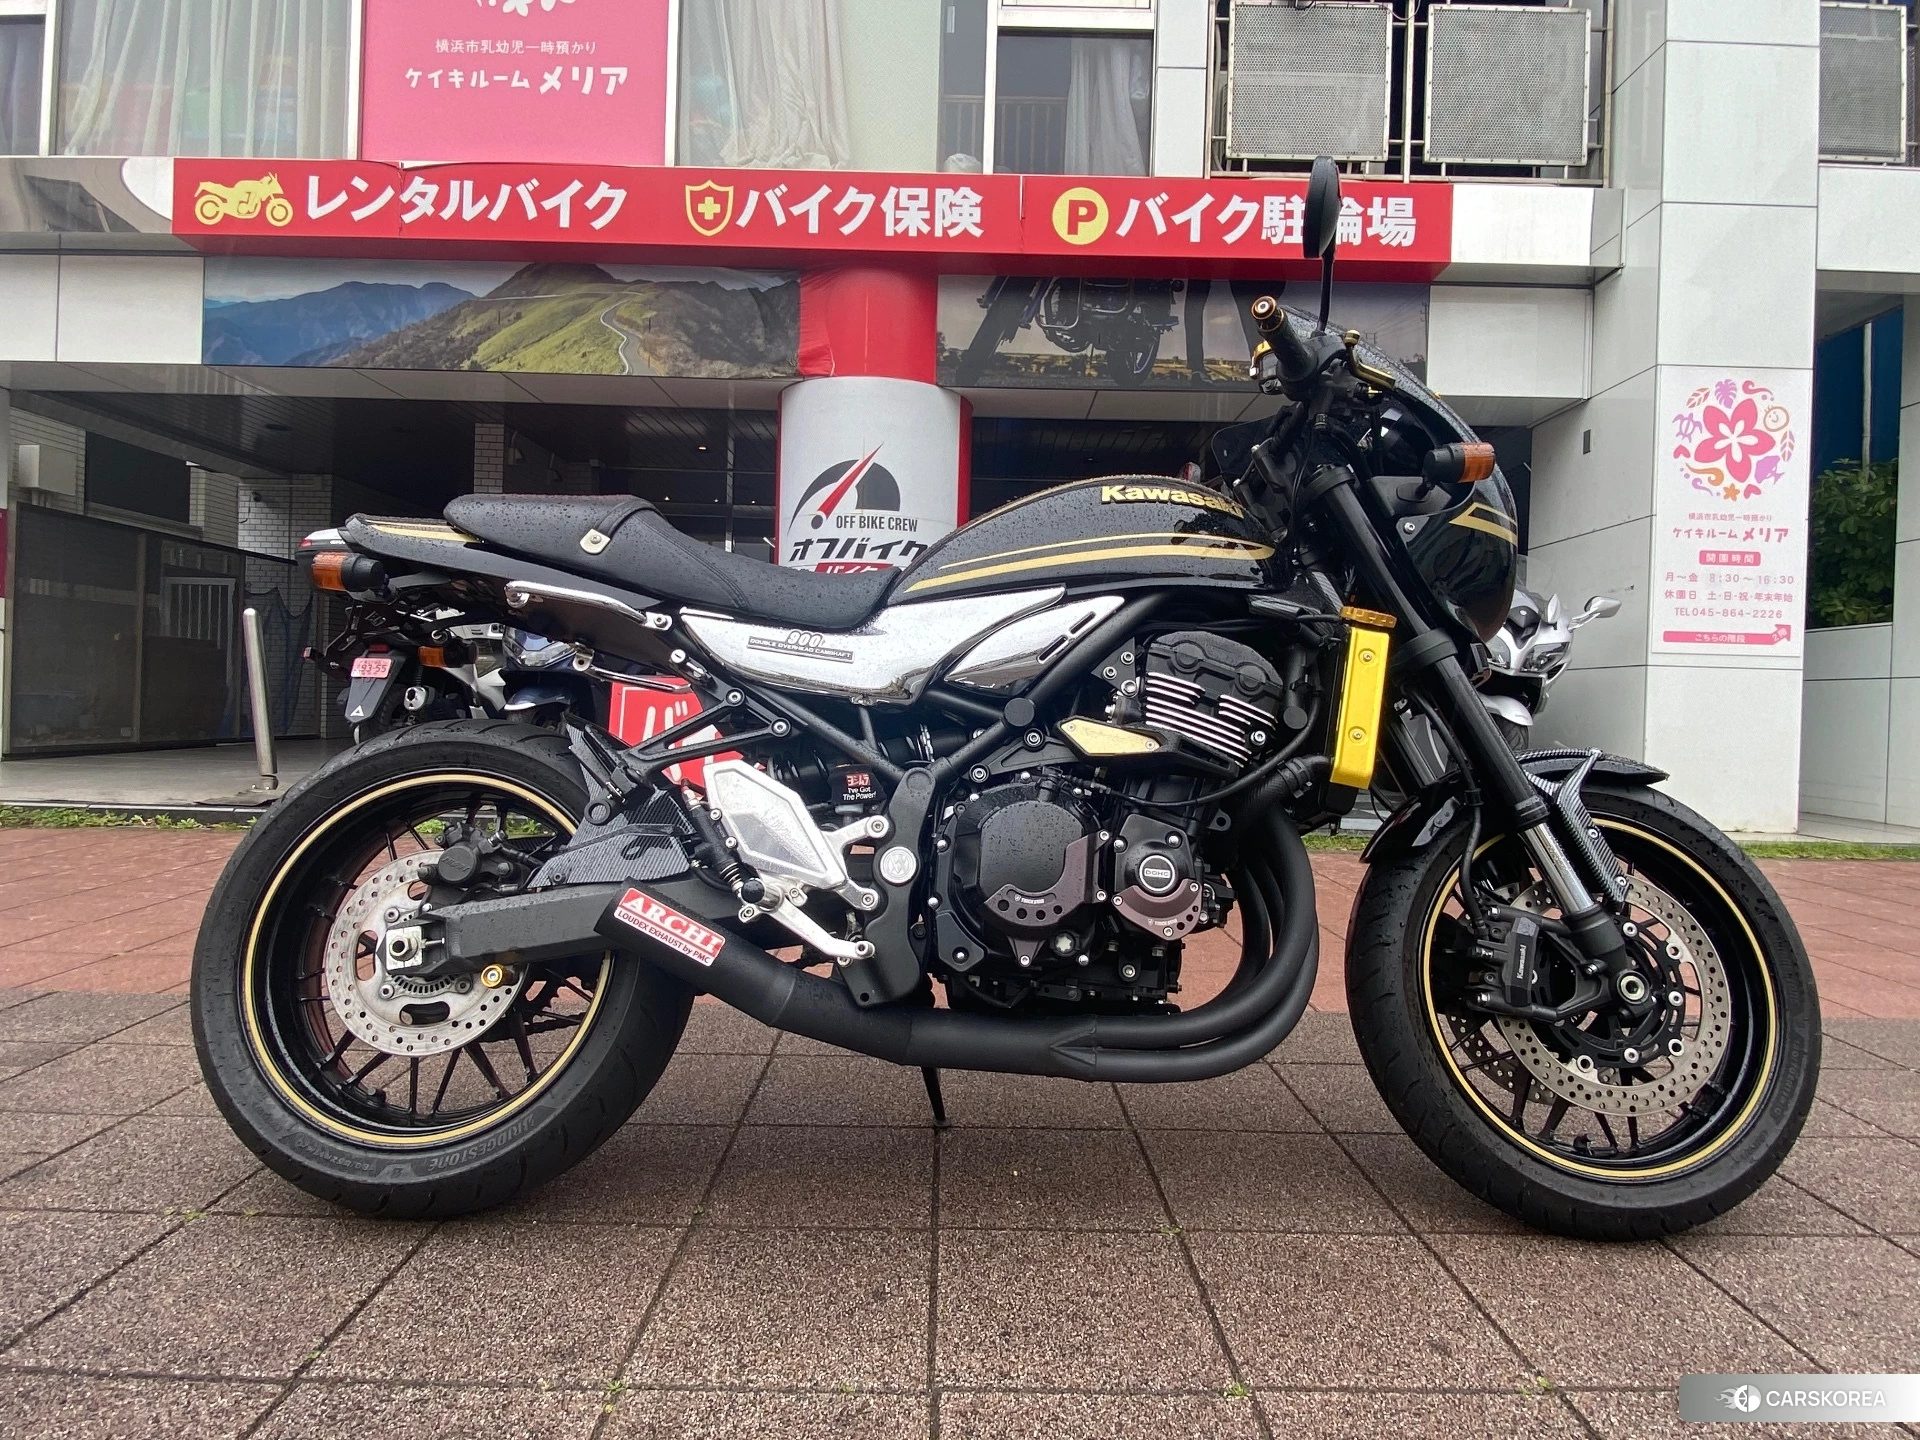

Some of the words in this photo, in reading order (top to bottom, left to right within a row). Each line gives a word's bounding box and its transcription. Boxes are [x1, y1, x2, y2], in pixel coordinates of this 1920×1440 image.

[435, 38, 597, 56] 横浜市乳幼児一時預かり
[404, 67, 531, 89] ケイキルーム
[539, 65, 628, 96] メリア
[307, 175, 628, 231] レンタルバイク
[735, 183, 985, 238] バイク保険
[1100, 484, 1245, 520] Kawasaki
[836, 515, 857, 529] OFF
[858, 515, 885, 530] BIKE
[888, 516, 918, 533] CREW
[1672, 527, 1737, 538] ケイキルーム
[1742, 527, 1788, 542] メリア
[789, 537, 929, 563] オフバイク
[1705, 552, 1754, 563] 開園時間
[1664, 589, 1697, 599] 休園日
[787, 630, 824, 648] 900
[1694, 633, 1745, 643] こちらの階段
[749, 637, 777, 648] DOUBLE
[777, 643, 815, 653] OVERHEAD
[814, 648, 852, 658] CAMSHAFT
[842, 793, 856, 801] The
[1145, 869, 1170, 877] DOHC
[622, 896, 721, 954] ARCHI
[617, 909, 650, 931] LOUDEX
[648, 926, 684, 949] EXHAUST
[682, 943, 693, 956] by
[692, 950, 712, 964] PMC
